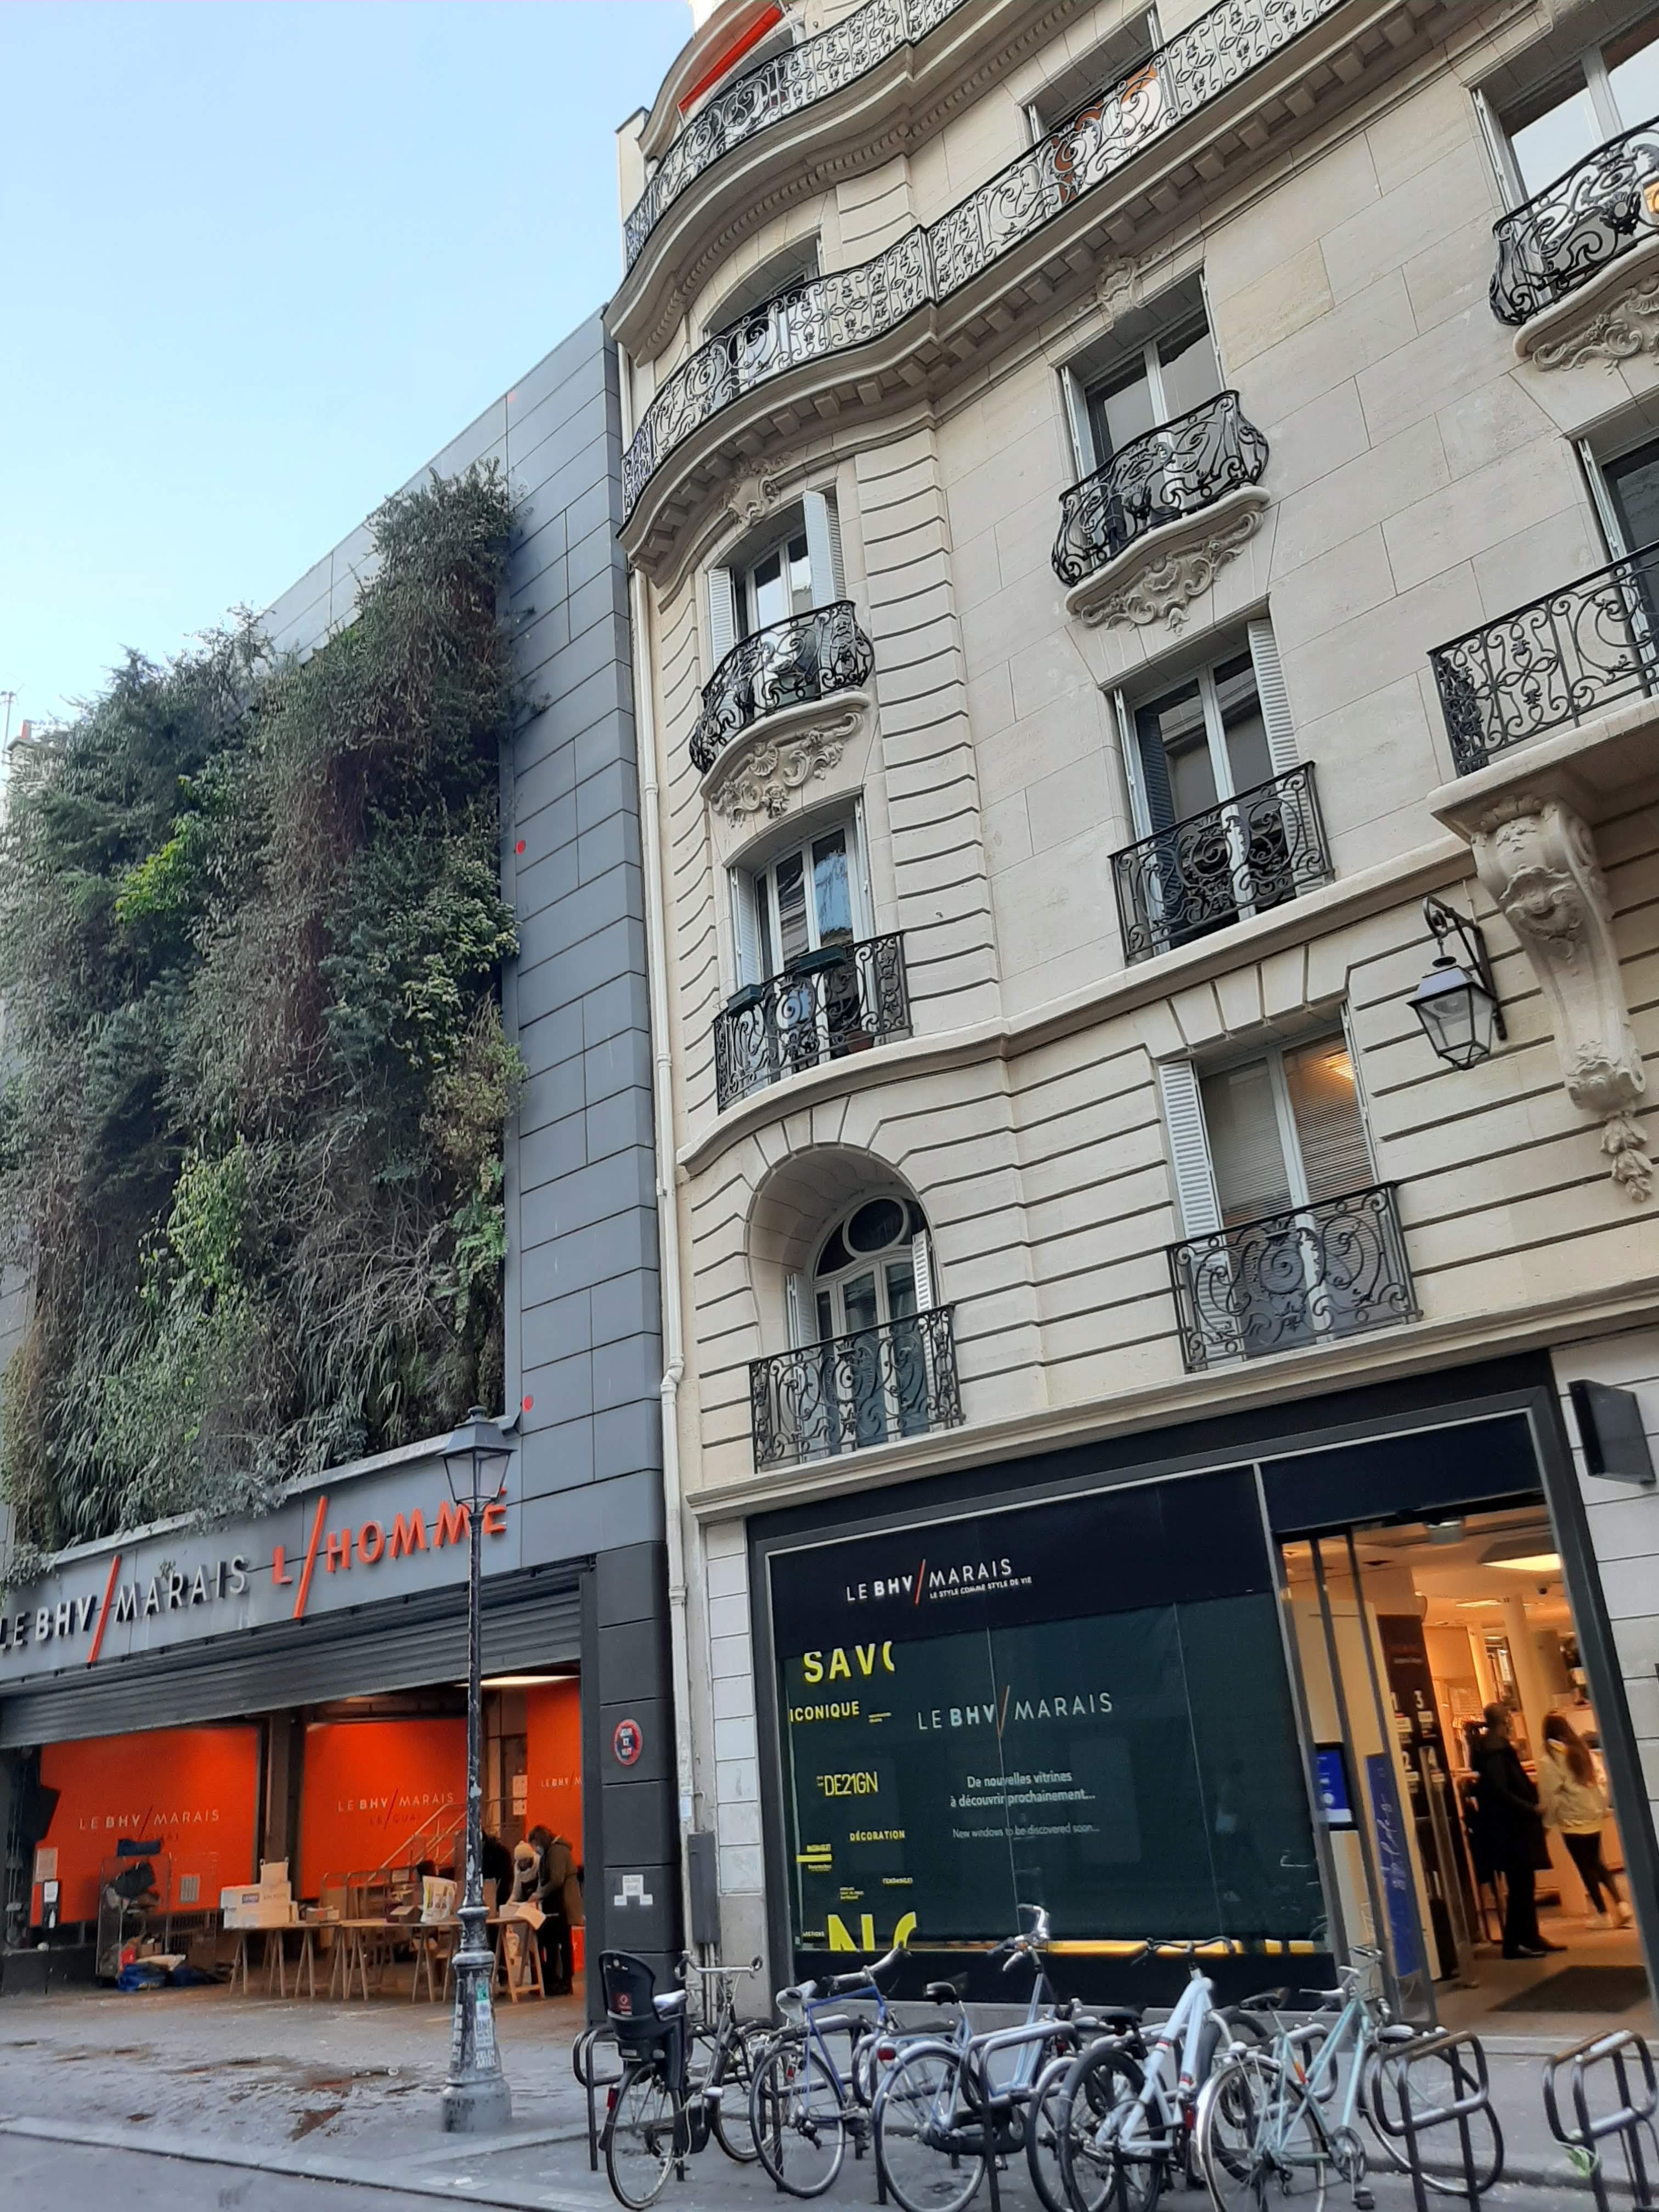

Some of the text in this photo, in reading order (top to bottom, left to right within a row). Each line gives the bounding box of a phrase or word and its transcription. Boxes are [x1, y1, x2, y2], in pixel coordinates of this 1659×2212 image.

[847, 1583, 867, 1601] LE
[939, 1588, 958, 1598] STYLE
[961, 1584, 985, 1594] COMME
[988, 1580, 1008, 1589] STYLE
[789, 1701, 860, 1722] ICONIQUE
[918, 1709, 943, 1730] LE
[967, 1770, 1073, 1788] De nouvelles vitrines
[338, 1800, 354, 1812] LE
[950, 1795, 957, 1807] à
[959, 1792, 1005, 1807] découvrir
[850, 1830, 905, 1842] DÉCORATION
